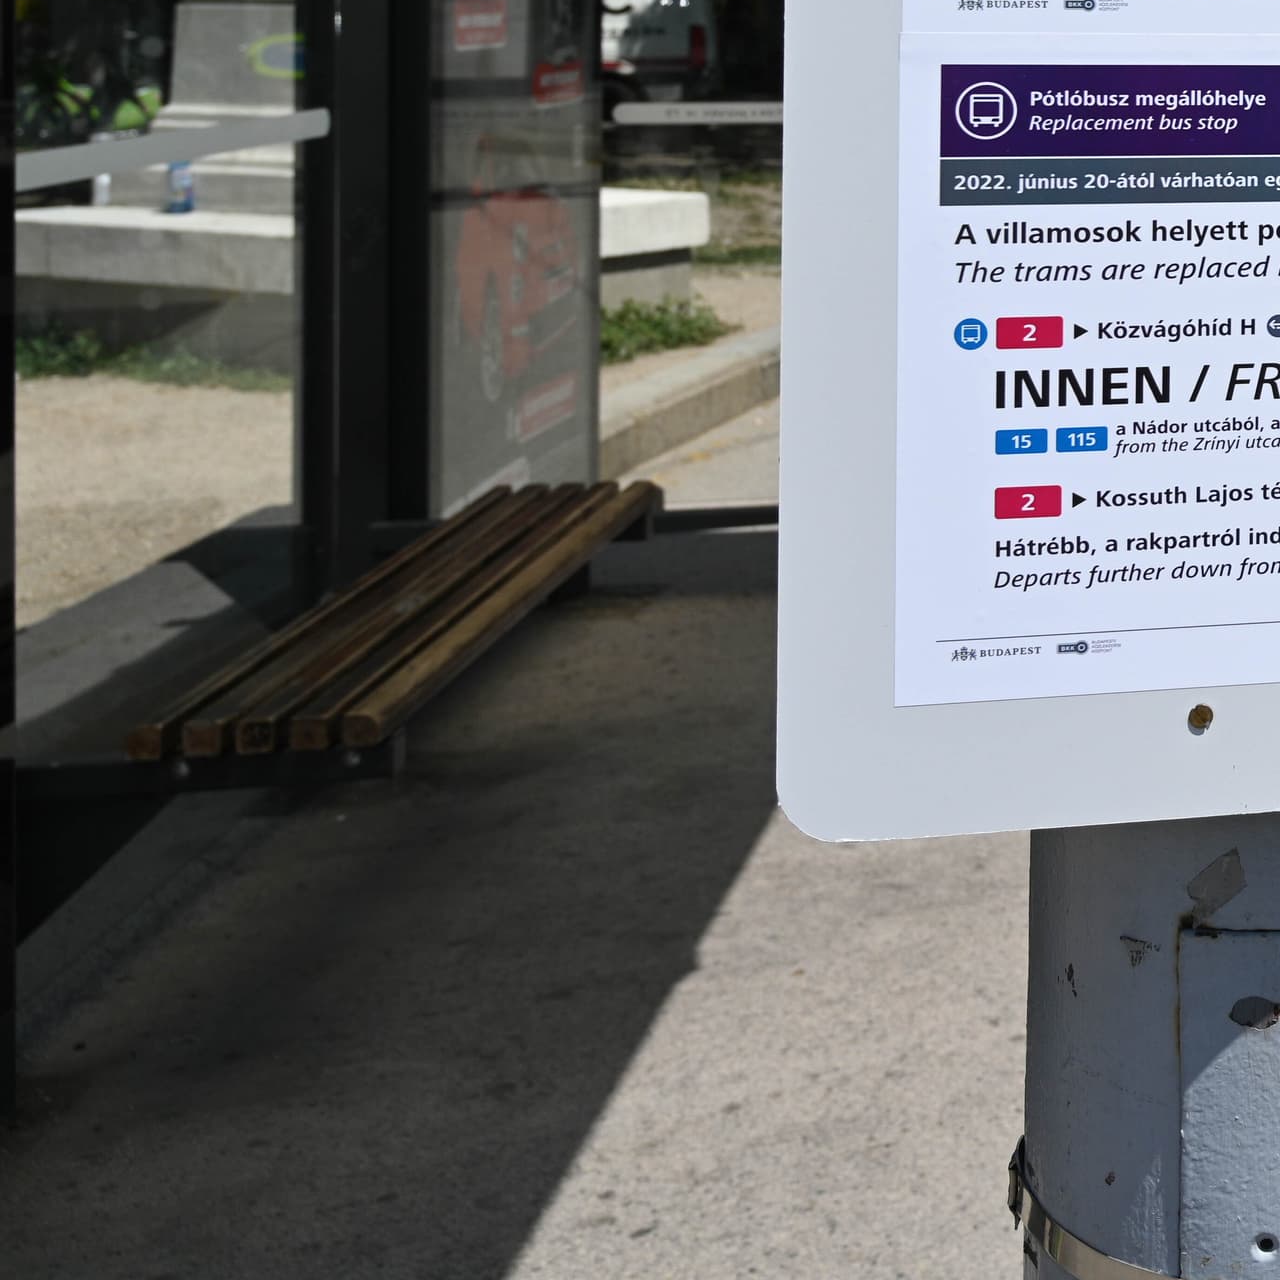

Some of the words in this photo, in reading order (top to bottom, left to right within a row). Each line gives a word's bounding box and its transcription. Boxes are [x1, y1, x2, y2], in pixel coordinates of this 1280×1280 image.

[986, 0, 1048, 8] BUDAPEST
[1030, 90, 1129, 106] Pótlóbusz
[1136, 90, 1266, 110] megállóhelye
[1029, 114, 1154, 135] Replacement
[1159, 114, 1192, 130] bus
[1197, 116, 1238, 134] stop
[954, 224, 976, 245] A
[986, 220, 1142, 244] villamosok
[1152, 219, 1248, 247] helyett
[1023, 324, 1036, 341] 2
[1098, 318, 1231, 342] Közvágóhíd
[1241, 318, 1255, 335] H
[996, 366, 1170, 409] INNEN
[1189, 365, 1210, 402] /
[1012, 435, 1031, 448] 15
[1068, 432, 1096, 446] 115
[1116, 425, 1126, 436] a
[1133, 419, 1188, 435] Nádor
[1194, 416, 1264, 433] utcából,
[1271, 419, 1280, 430] a
[1021, 494, 1035, 511] 2
[1097, 486, 1187, 507] Kossuth
[1196, 484, 1253, 507] Lajos
[996, 536, 1096, 558] Hátrébb,
[1105, 539, 1118, 552] a
[1127, 528, 1240, 554] rakpartról
[979, 646, 1042, 657] BUDAPEST
